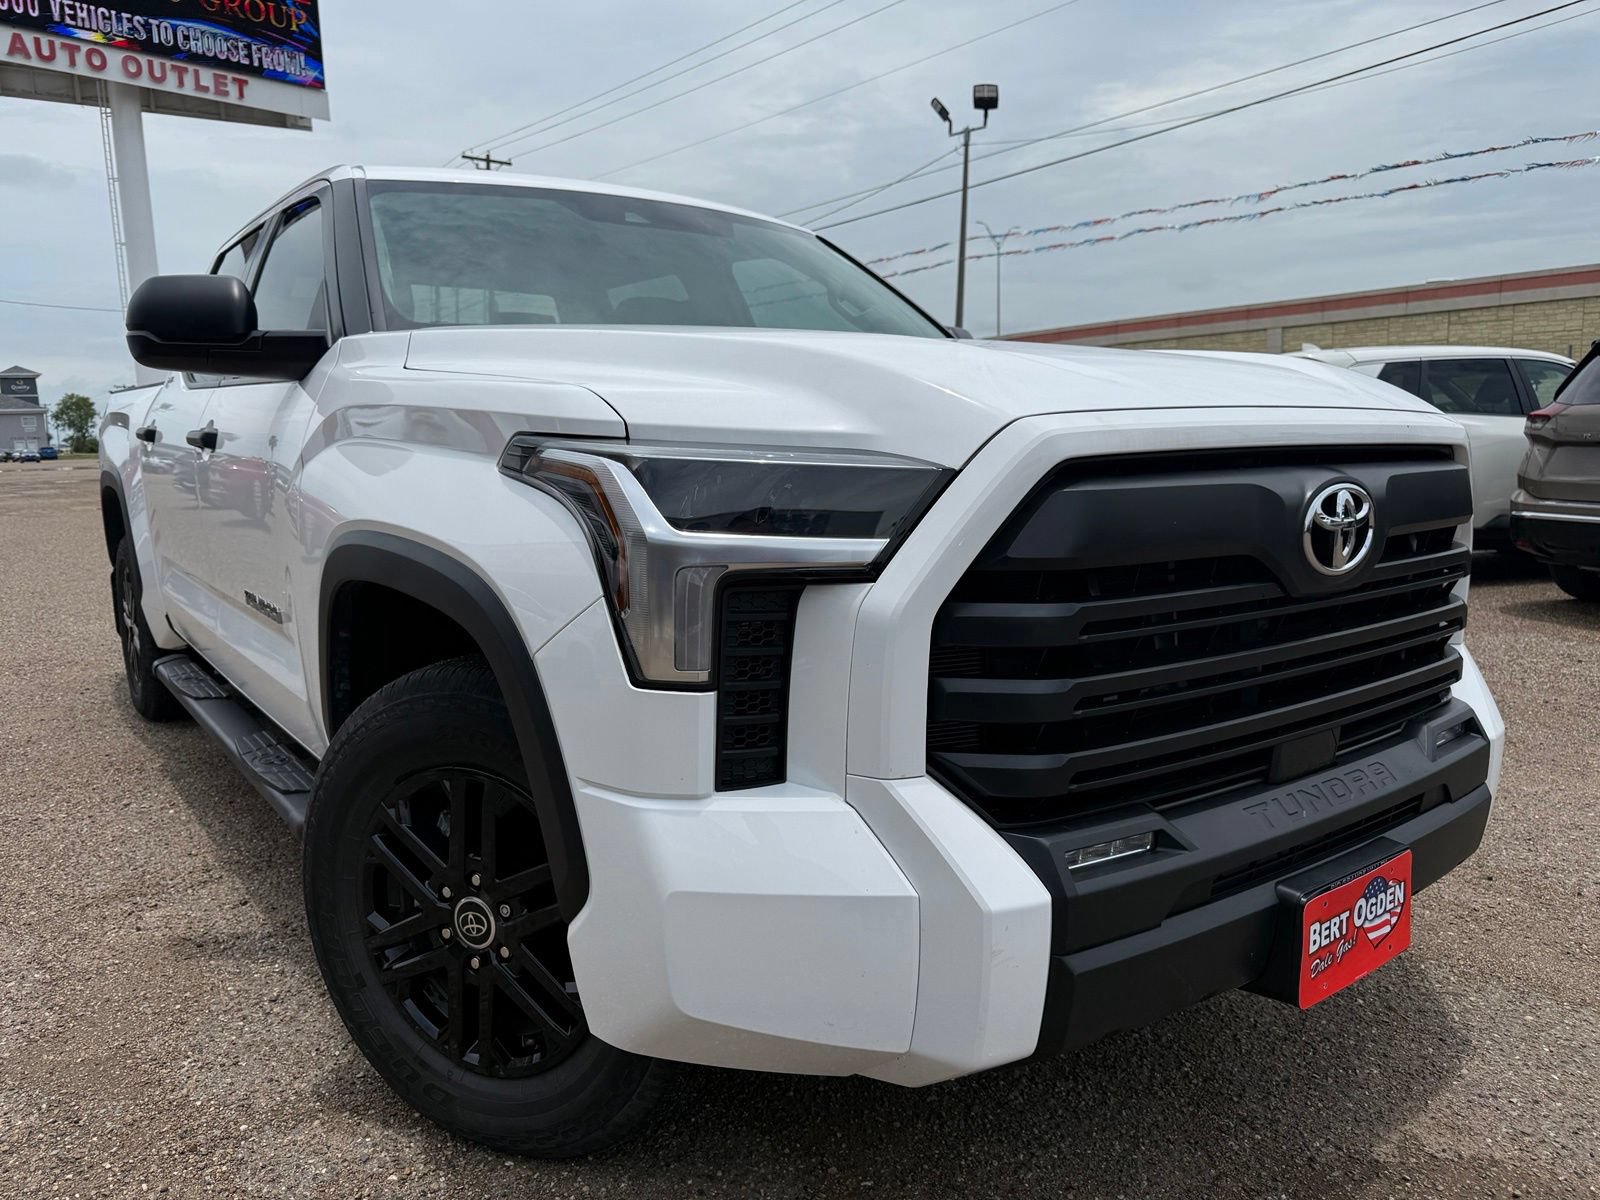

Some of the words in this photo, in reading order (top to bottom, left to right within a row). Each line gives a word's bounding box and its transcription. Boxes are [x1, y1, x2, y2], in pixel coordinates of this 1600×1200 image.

[6, 32, 108, 72] AUTO
[121, 54, 249, 100] OUTLET
[50, 0, 146, 40] VEHICLES
[148, 19, 173, 47] TO
[177, 25, 250, 65] CHOOSE
[251, 42, 307, 77] FROM!
[1242, 761, 1398, 828] TUNDRA
[1309, 910, 1350, 955] BERT
[1353, 881, 1405, 928] OGDEN
[1310, 952, 1333, 978] Dale
